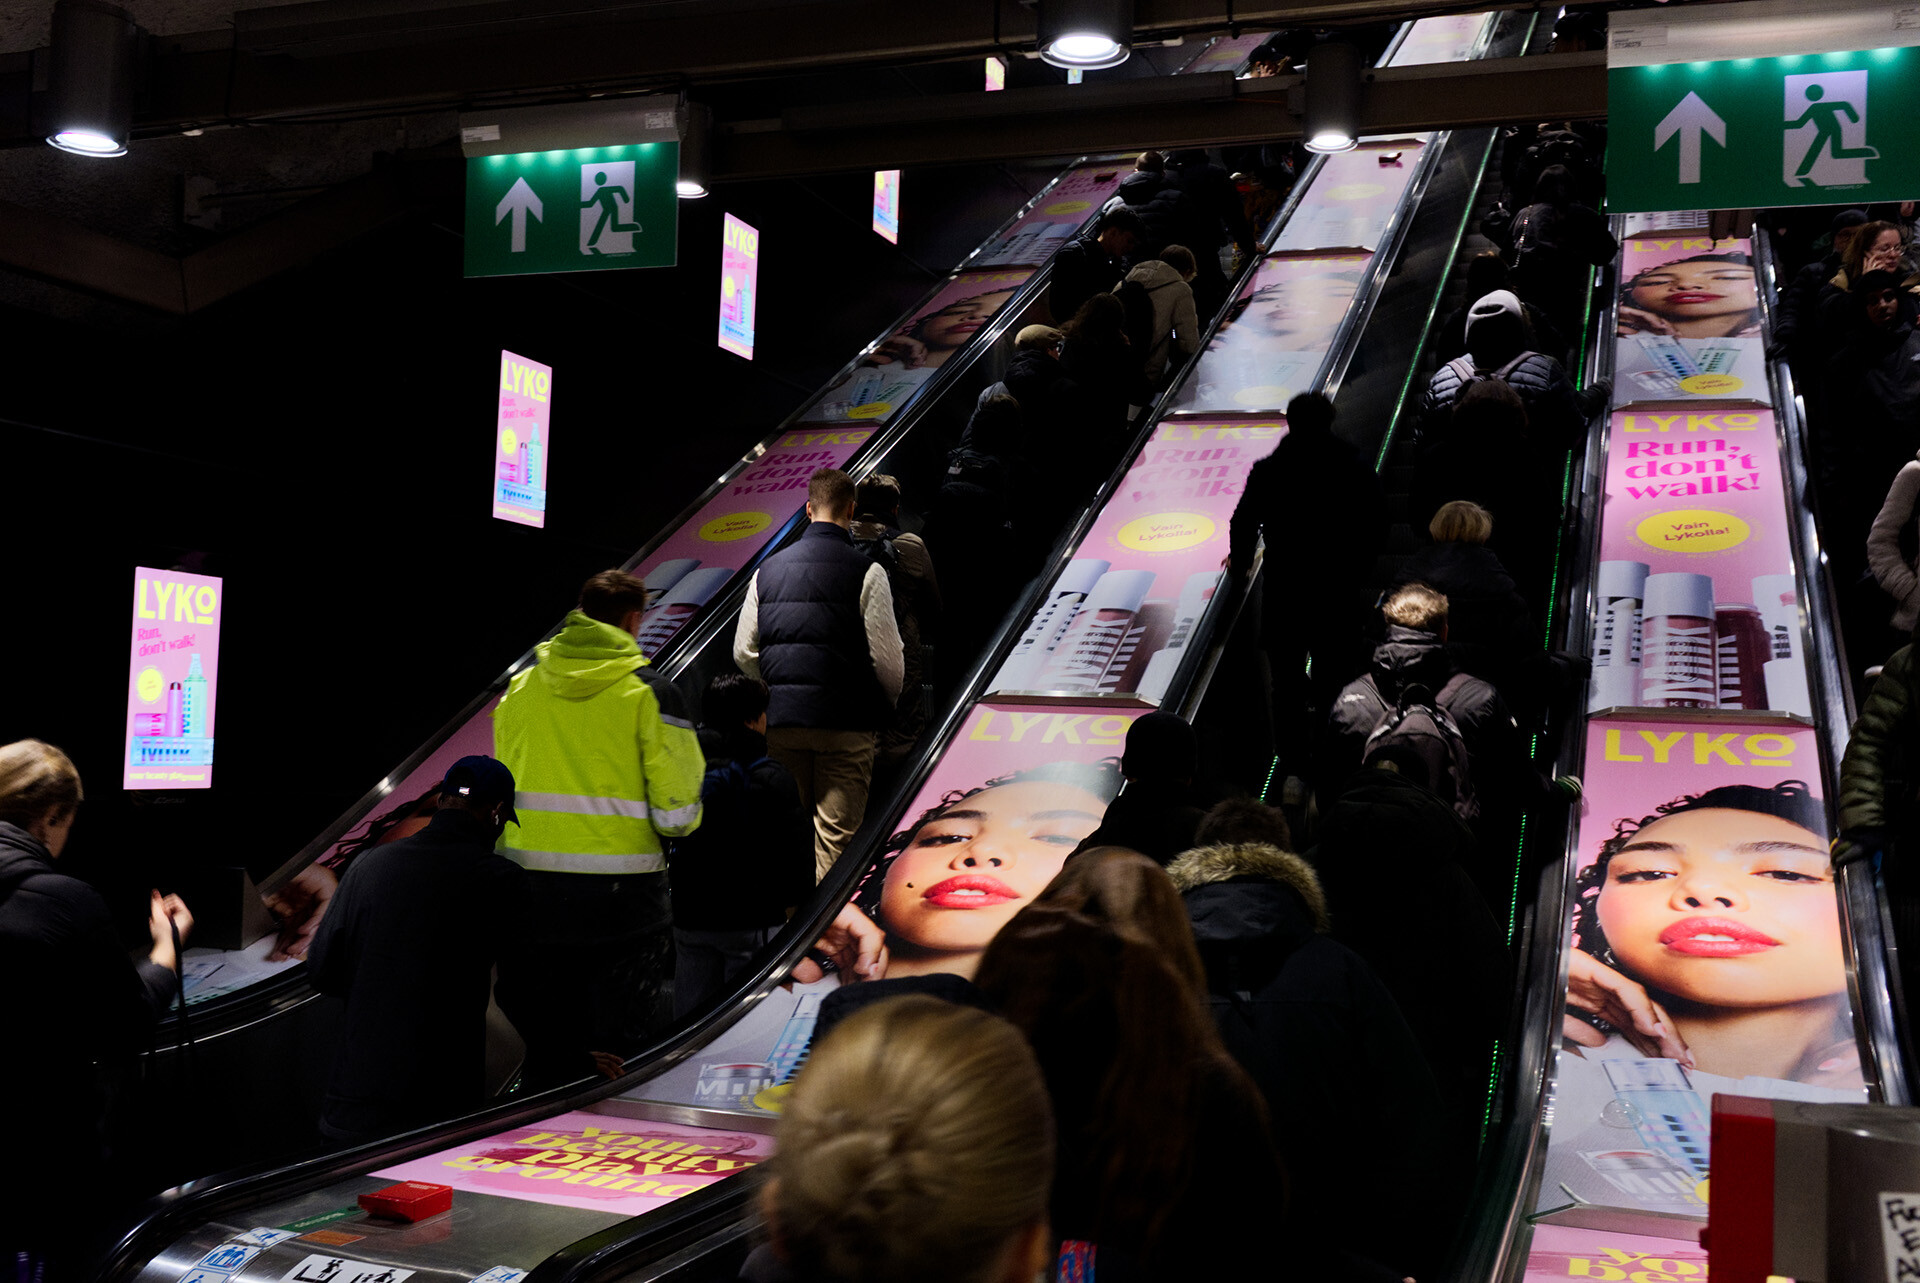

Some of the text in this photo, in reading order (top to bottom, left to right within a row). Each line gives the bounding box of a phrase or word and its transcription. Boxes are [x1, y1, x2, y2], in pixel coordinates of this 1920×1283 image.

[724, 219, 757, 259] LYKO
[502, 359, 549, 403] LYKO
[1160, 424, 1283, 441] LYKO
[1624, 414, 1759, 433] LYKO
[780, 431, 871, 448] LYKO
[1626, 438, 1741, 459] Run,
[1625, 454, 1760, 479] don't
[1625, 473, 1760, 500] walk!
[1138, 528, 1198, 542] Lykolla!
[1149, 524, 1183, 532] Vain
[1664, 527, 1730, 541] Lykolla!
[1672, 522, 1709, 531] Vain
[137, 578, 217, 625] LYKO
[968, 712, 1134, 745] LYKO
[1604, 729, 1797, 767] LYKO
[515, 1132, 758, 1173] beauty
[517, 1149, 690, 1178] play
